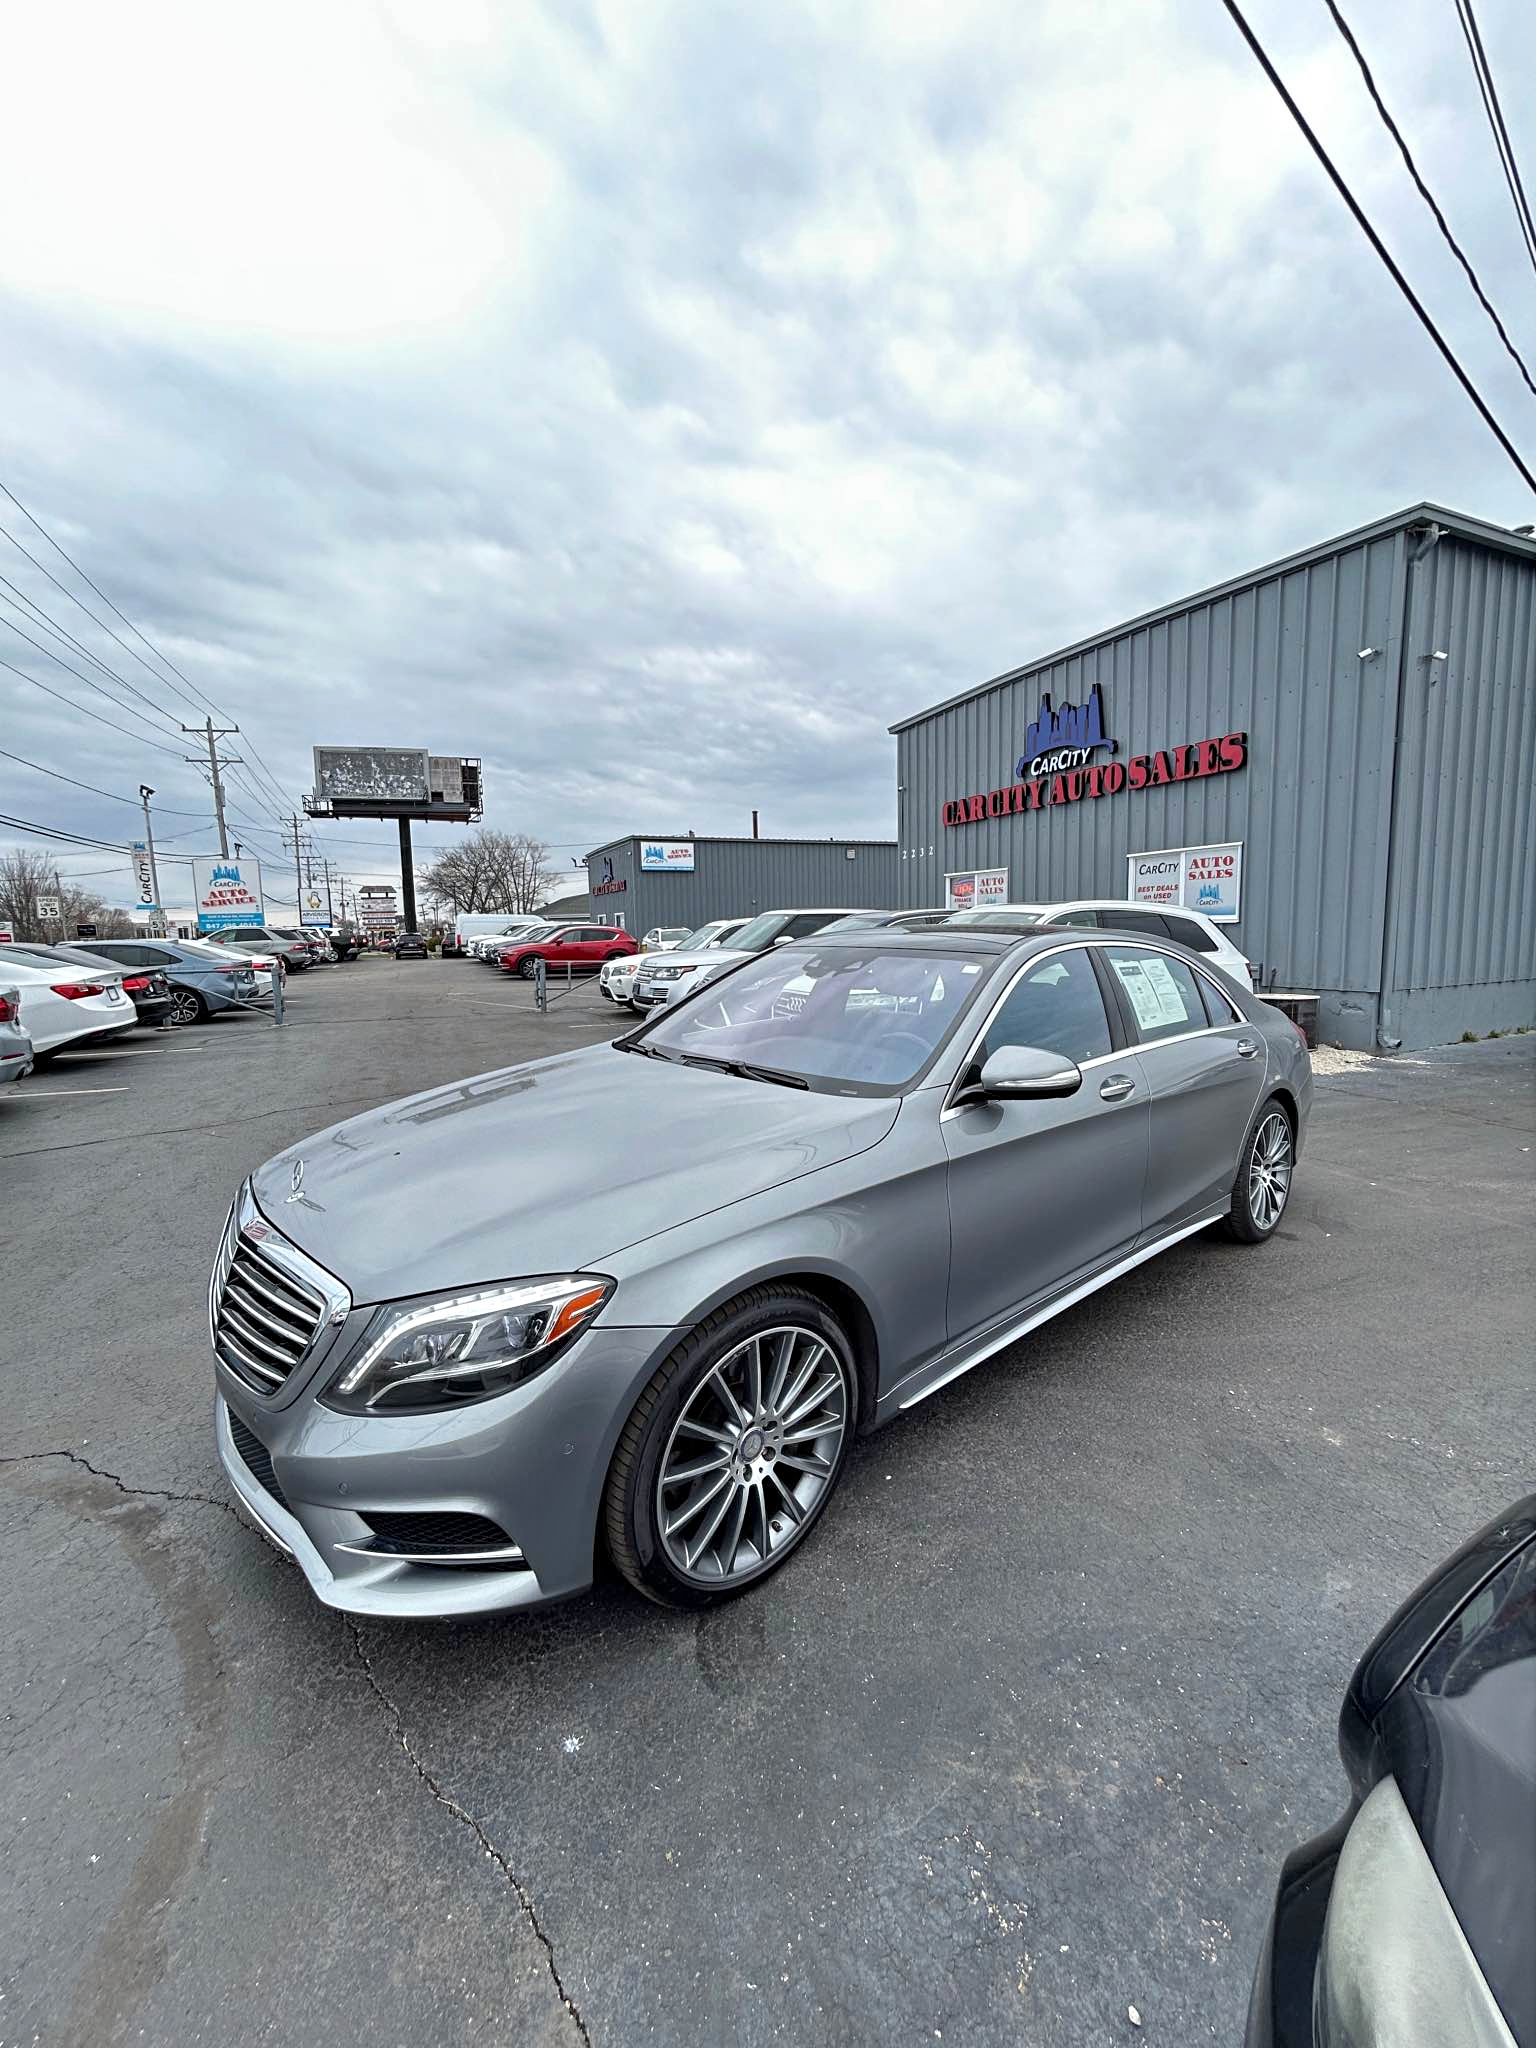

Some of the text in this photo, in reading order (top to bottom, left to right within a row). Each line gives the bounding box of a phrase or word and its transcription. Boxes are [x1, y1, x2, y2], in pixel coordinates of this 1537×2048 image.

[1030, 747, 1091, 776] CARCITY
[943, 732, 1247, 827] CAR CITY AUTO SALES
[902, 846, 934, 860] 2232
[1189, 856, 1234, 869] AUTO
[1139, 862, 1179, 875] CARCITY
[1188, 869, 1234, 880] SALES
[139, 862, 153, 904] CARCITY
[980, 877, 1004, 887] AUTO
[208, 888, 248, 899] AUTO
[980, 887, 1004, 895] SALES
[1156, 884, 1179, 892] DEALS
[201, 897, 257, 907] SERVICE
[40, 907, 58, 916] 35
